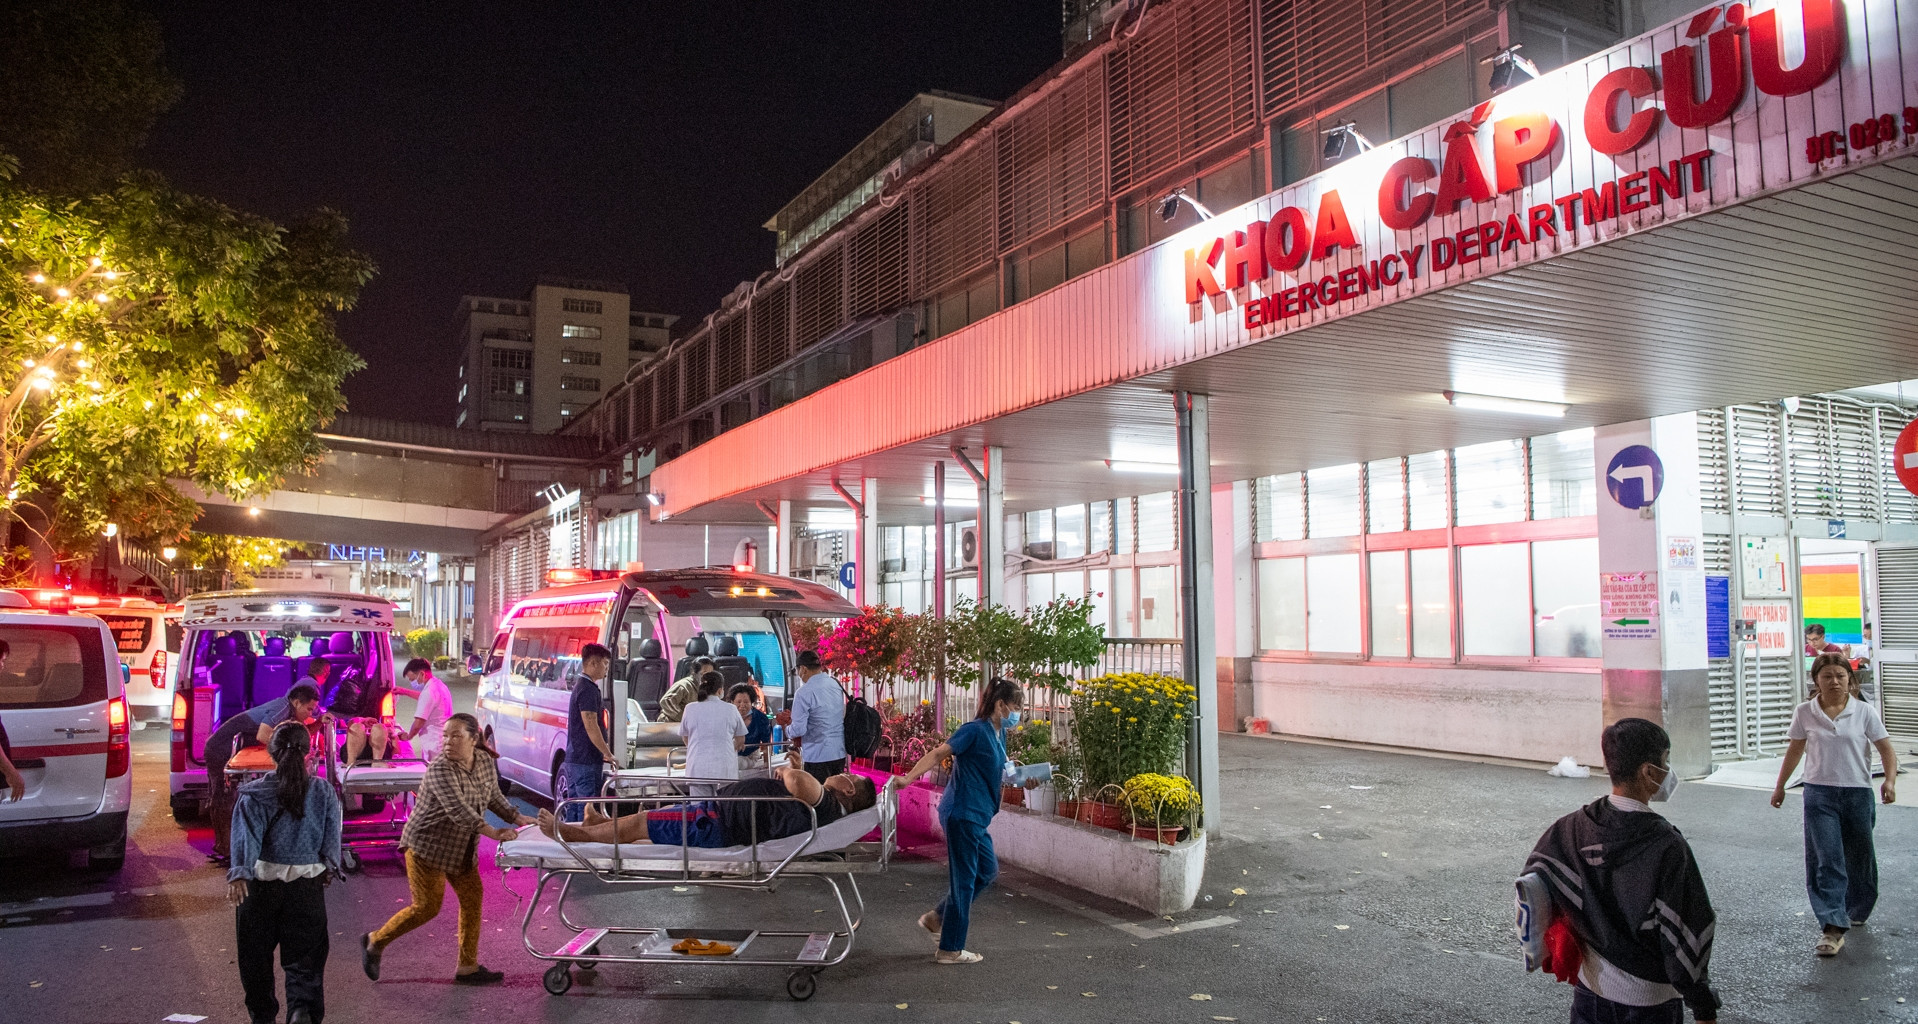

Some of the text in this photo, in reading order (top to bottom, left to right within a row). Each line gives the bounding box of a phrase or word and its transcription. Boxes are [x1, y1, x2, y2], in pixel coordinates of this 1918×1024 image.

[1185, 0, 1850, 304] KHOA CẤP CỨU
[1849, 113, 1897, 150] 028
[1245, 149, 1713, 329] EMERGENCY DEPARTMENT
[1742, 603, 1762, 622] KHÔNG
